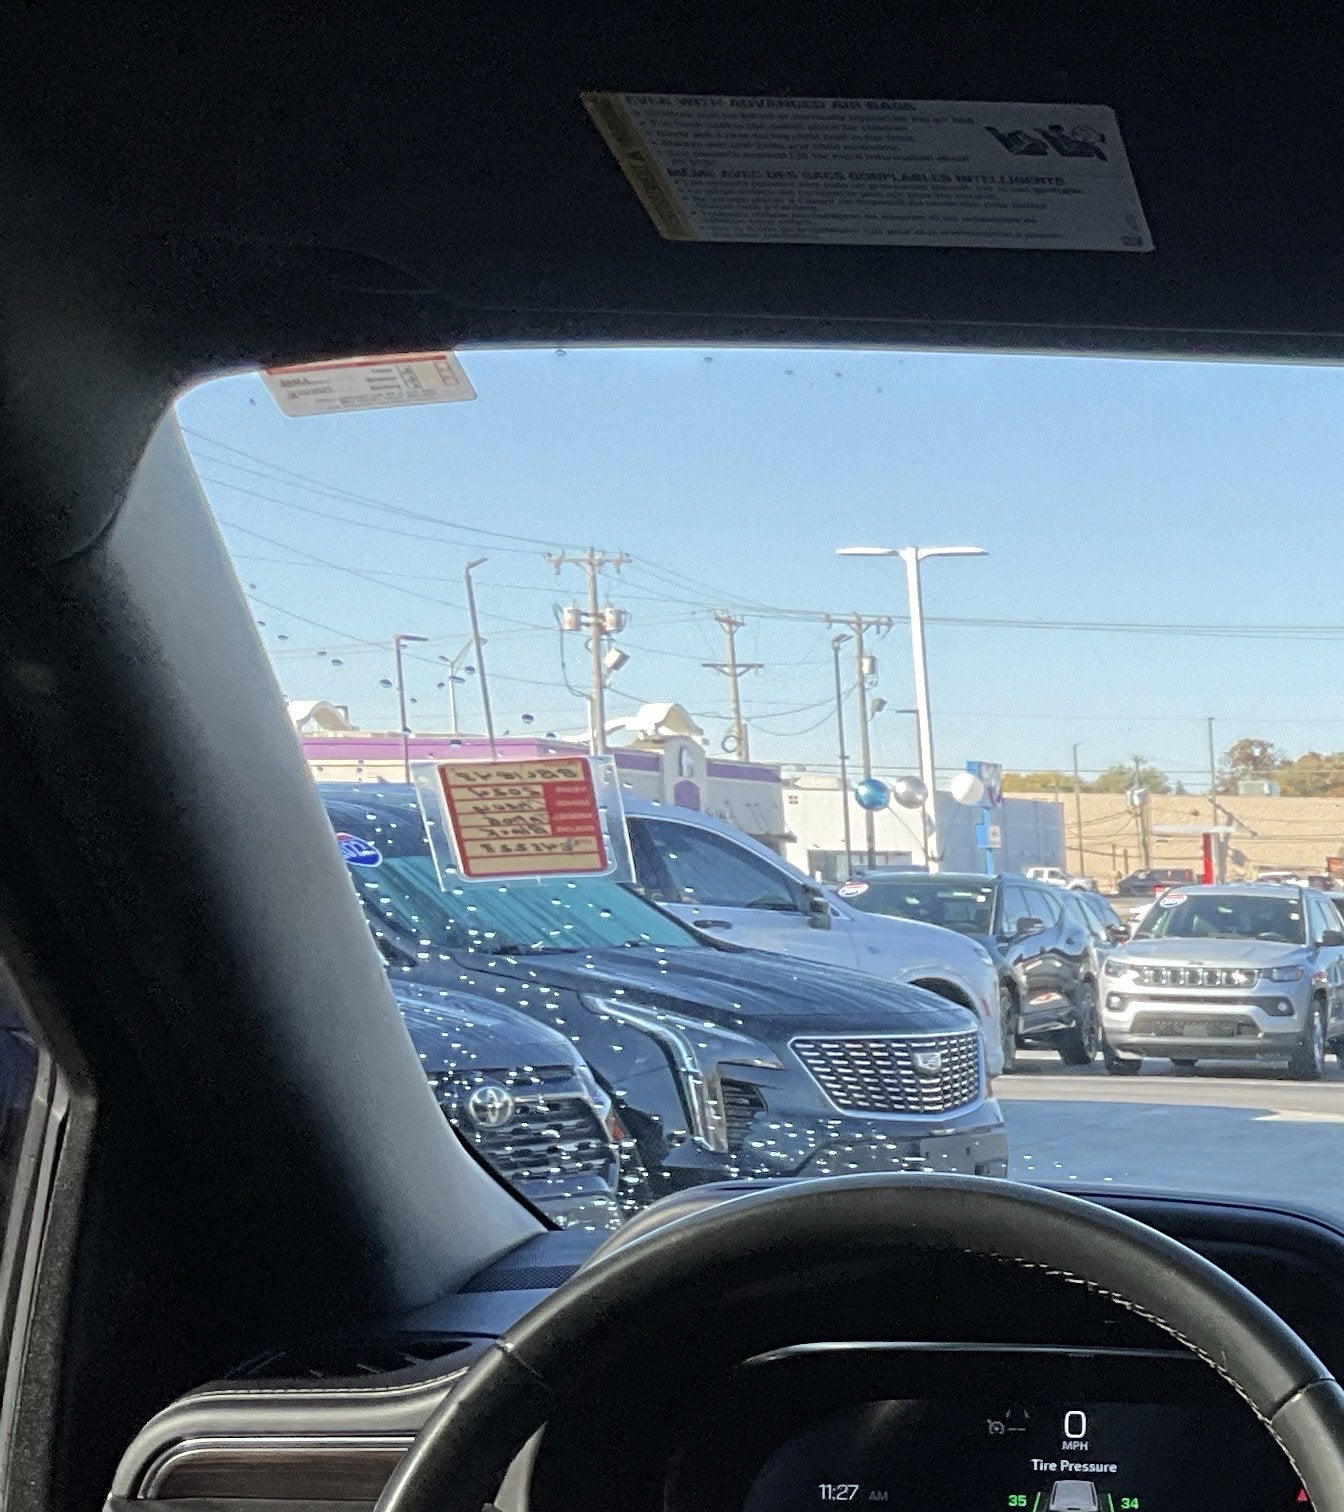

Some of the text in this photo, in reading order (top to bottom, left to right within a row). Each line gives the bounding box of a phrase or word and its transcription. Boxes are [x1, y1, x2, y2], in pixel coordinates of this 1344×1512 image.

[1064, 1410, 1087, 1439] 0
[1062, 1440, 1089, 1452] MPH
[1031, 1458, 1118, 1473] Tire Pressure
[817, 1484, 889, 1501] 11:27 AM
[1008, 1494, 1027, 1507] 35
[1120, 1497, 1139, 1510] 34
